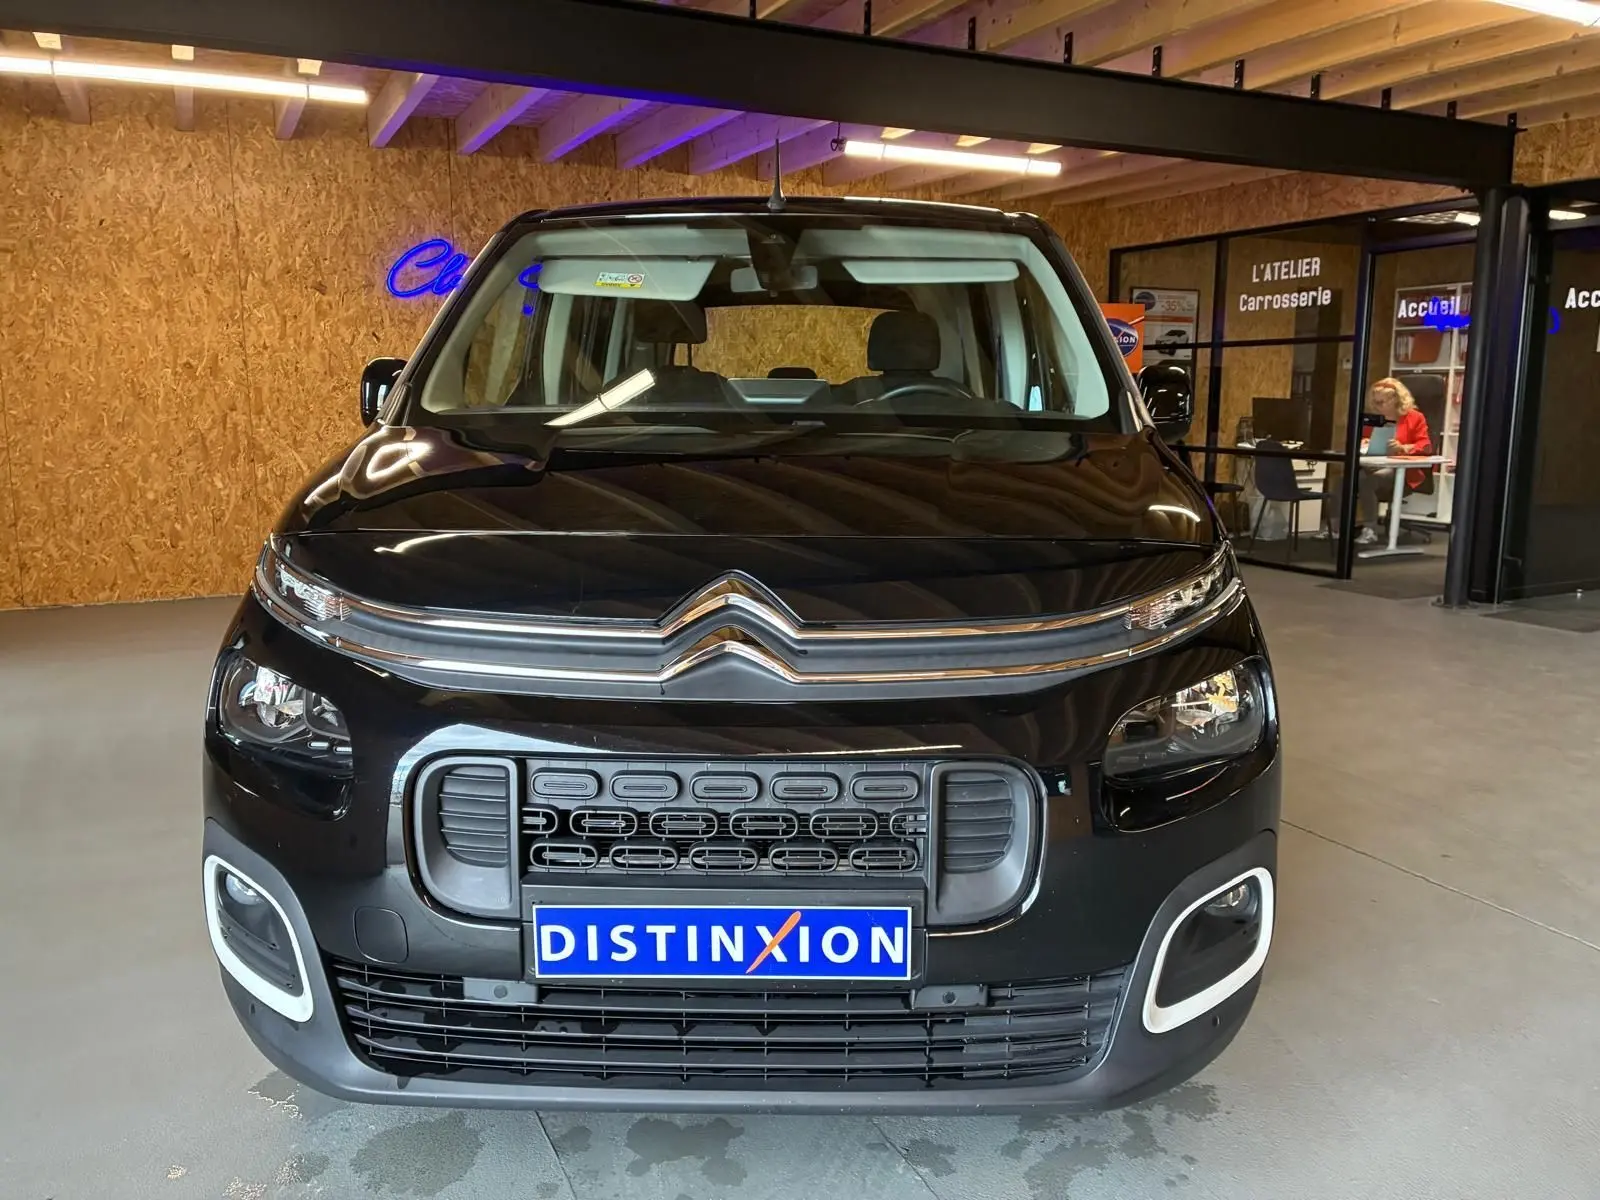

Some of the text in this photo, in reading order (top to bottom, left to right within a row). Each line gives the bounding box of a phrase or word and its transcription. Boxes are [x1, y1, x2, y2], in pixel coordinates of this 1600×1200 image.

[1252, 256, 1321, 283] L'ATELIER
[1239, 286, 1332, 312] Carrosserie
[1397, 295, 1461, 319] Accueil
[540, 919, 904, 968] DISTINXION
